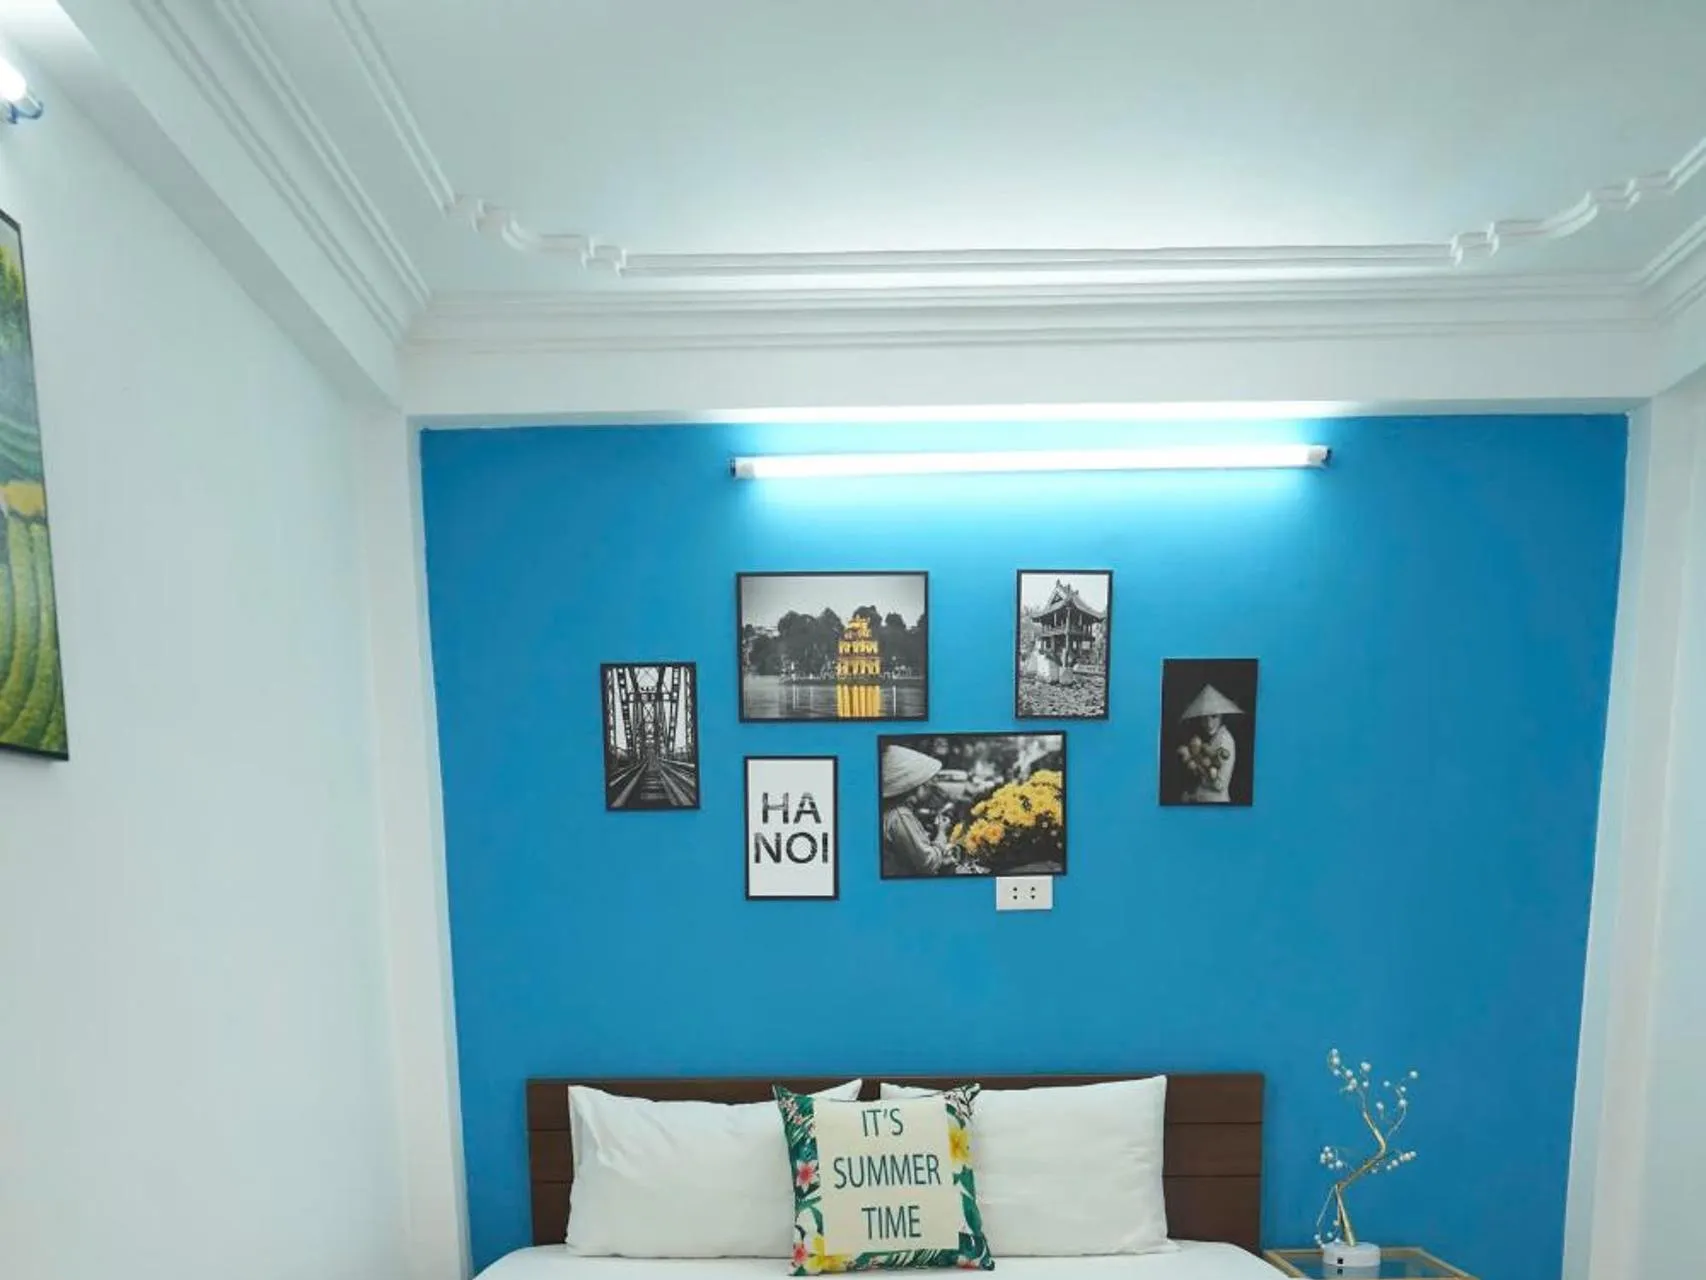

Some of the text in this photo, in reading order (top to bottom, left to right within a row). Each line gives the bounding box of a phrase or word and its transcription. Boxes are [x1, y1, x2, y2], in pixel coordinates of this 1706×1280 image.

[762, 792, 822, 824] HA
[754, 832, 828, 864] NOI
[861, 1108, 904, 1137] IT'S
[833, 1154, 941, 1189] SUMMER
[861, 1205, 922, 1240] TIME
